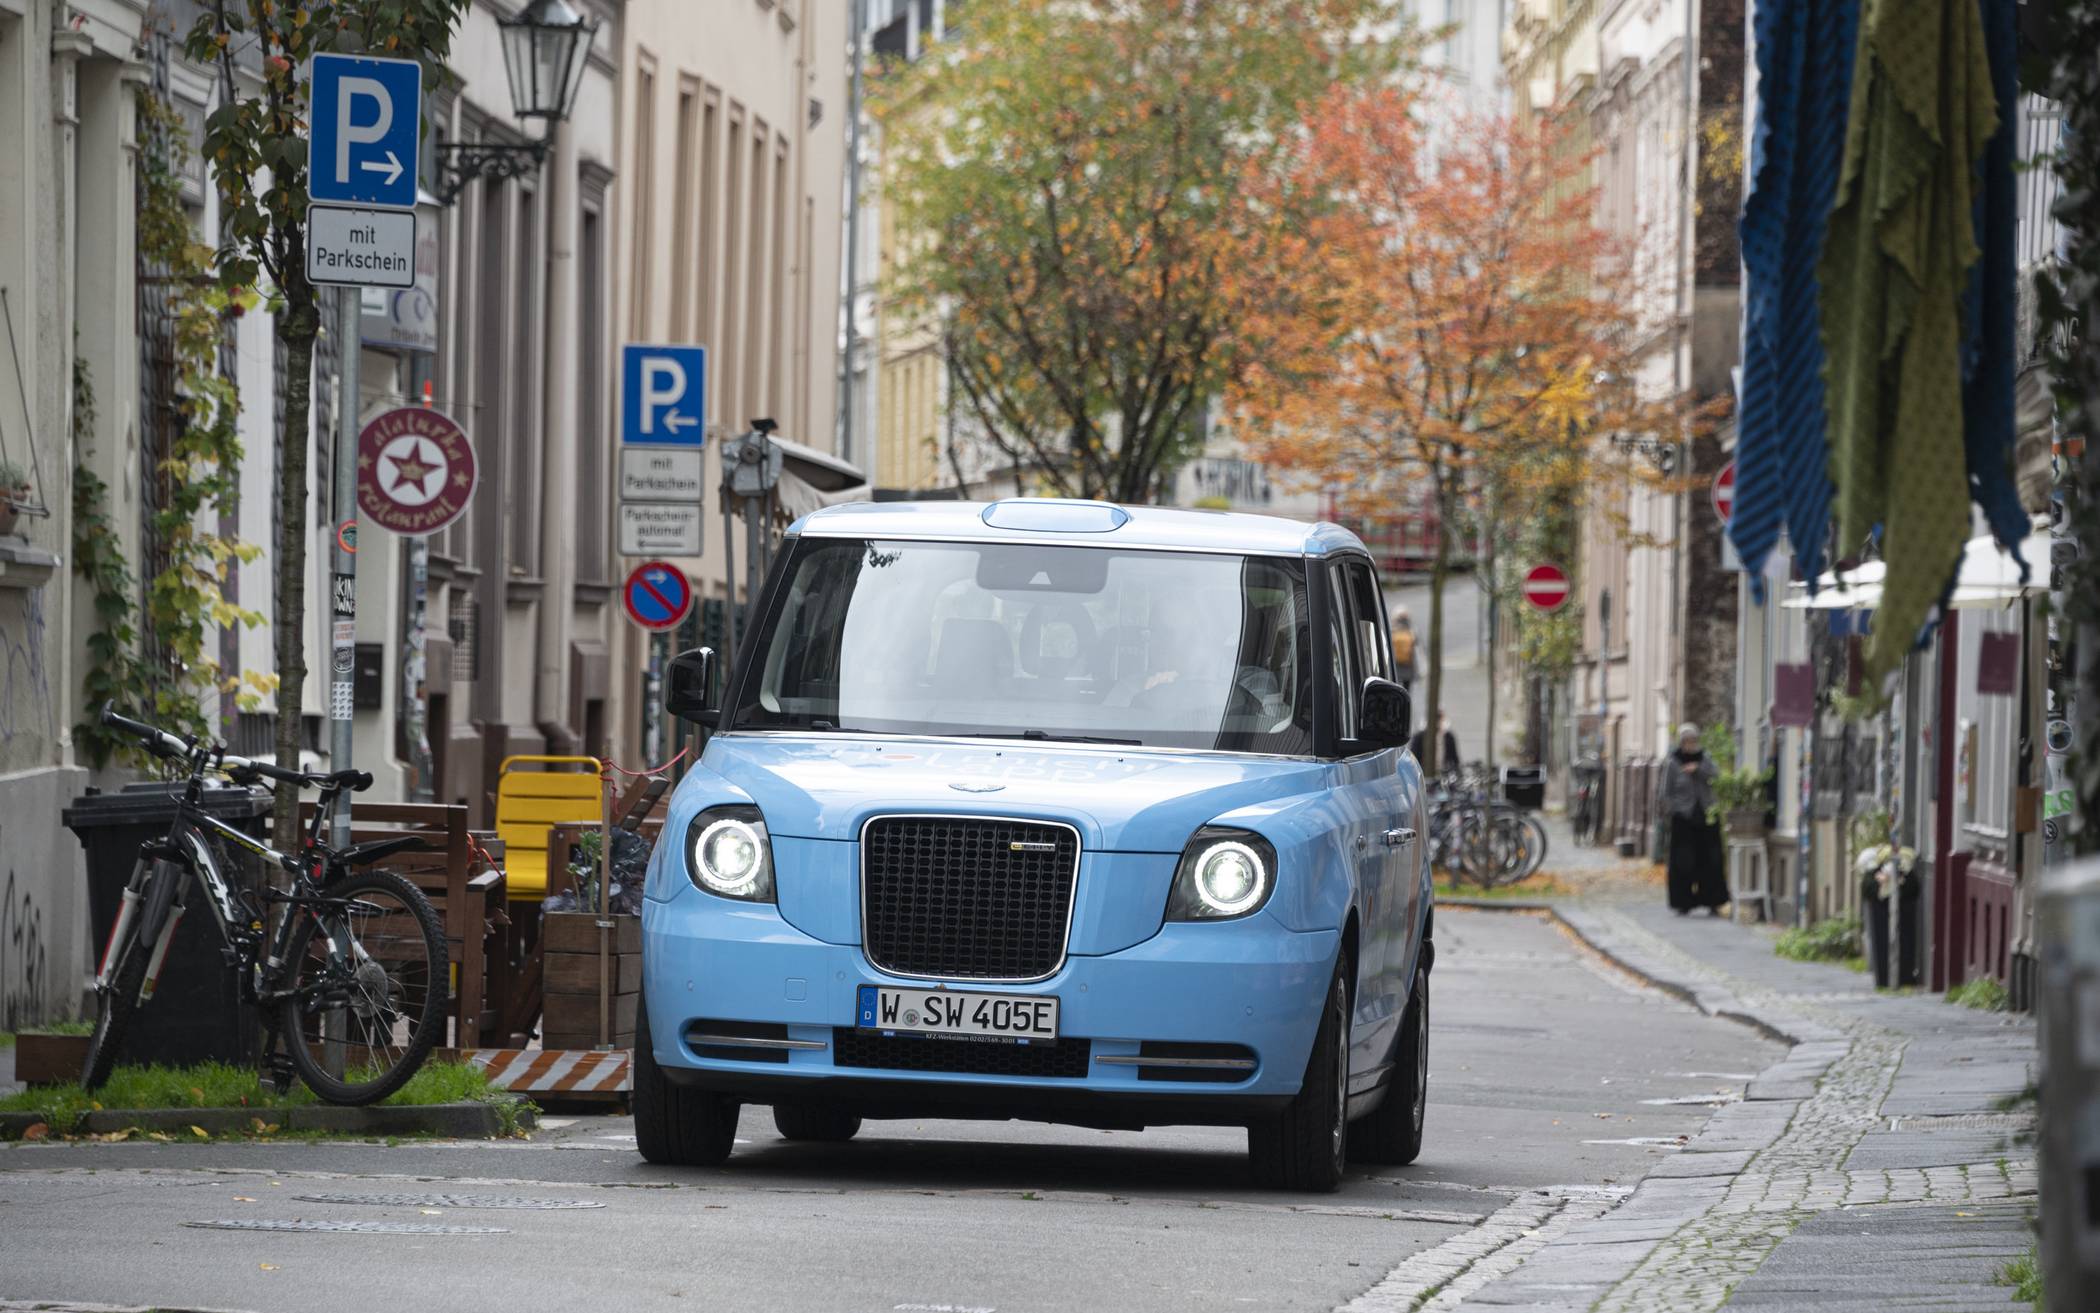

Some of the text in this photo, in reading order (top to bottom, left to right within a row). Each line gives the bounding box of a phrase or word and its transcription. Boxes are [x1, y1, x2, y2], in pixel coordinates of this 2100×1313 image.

[336, 76, 393, 183] P
[350, 225, 375, 244] mit
[316, 247, 407, 271] Parkschein
[640, 357, 687, 434] P
[651, 457, 672, 471] mit
[625, 474, 697, 491] Parkschein
[864, 1011, 872, 1020] D
[881, 993, 1052, 1033] W SW 405E
